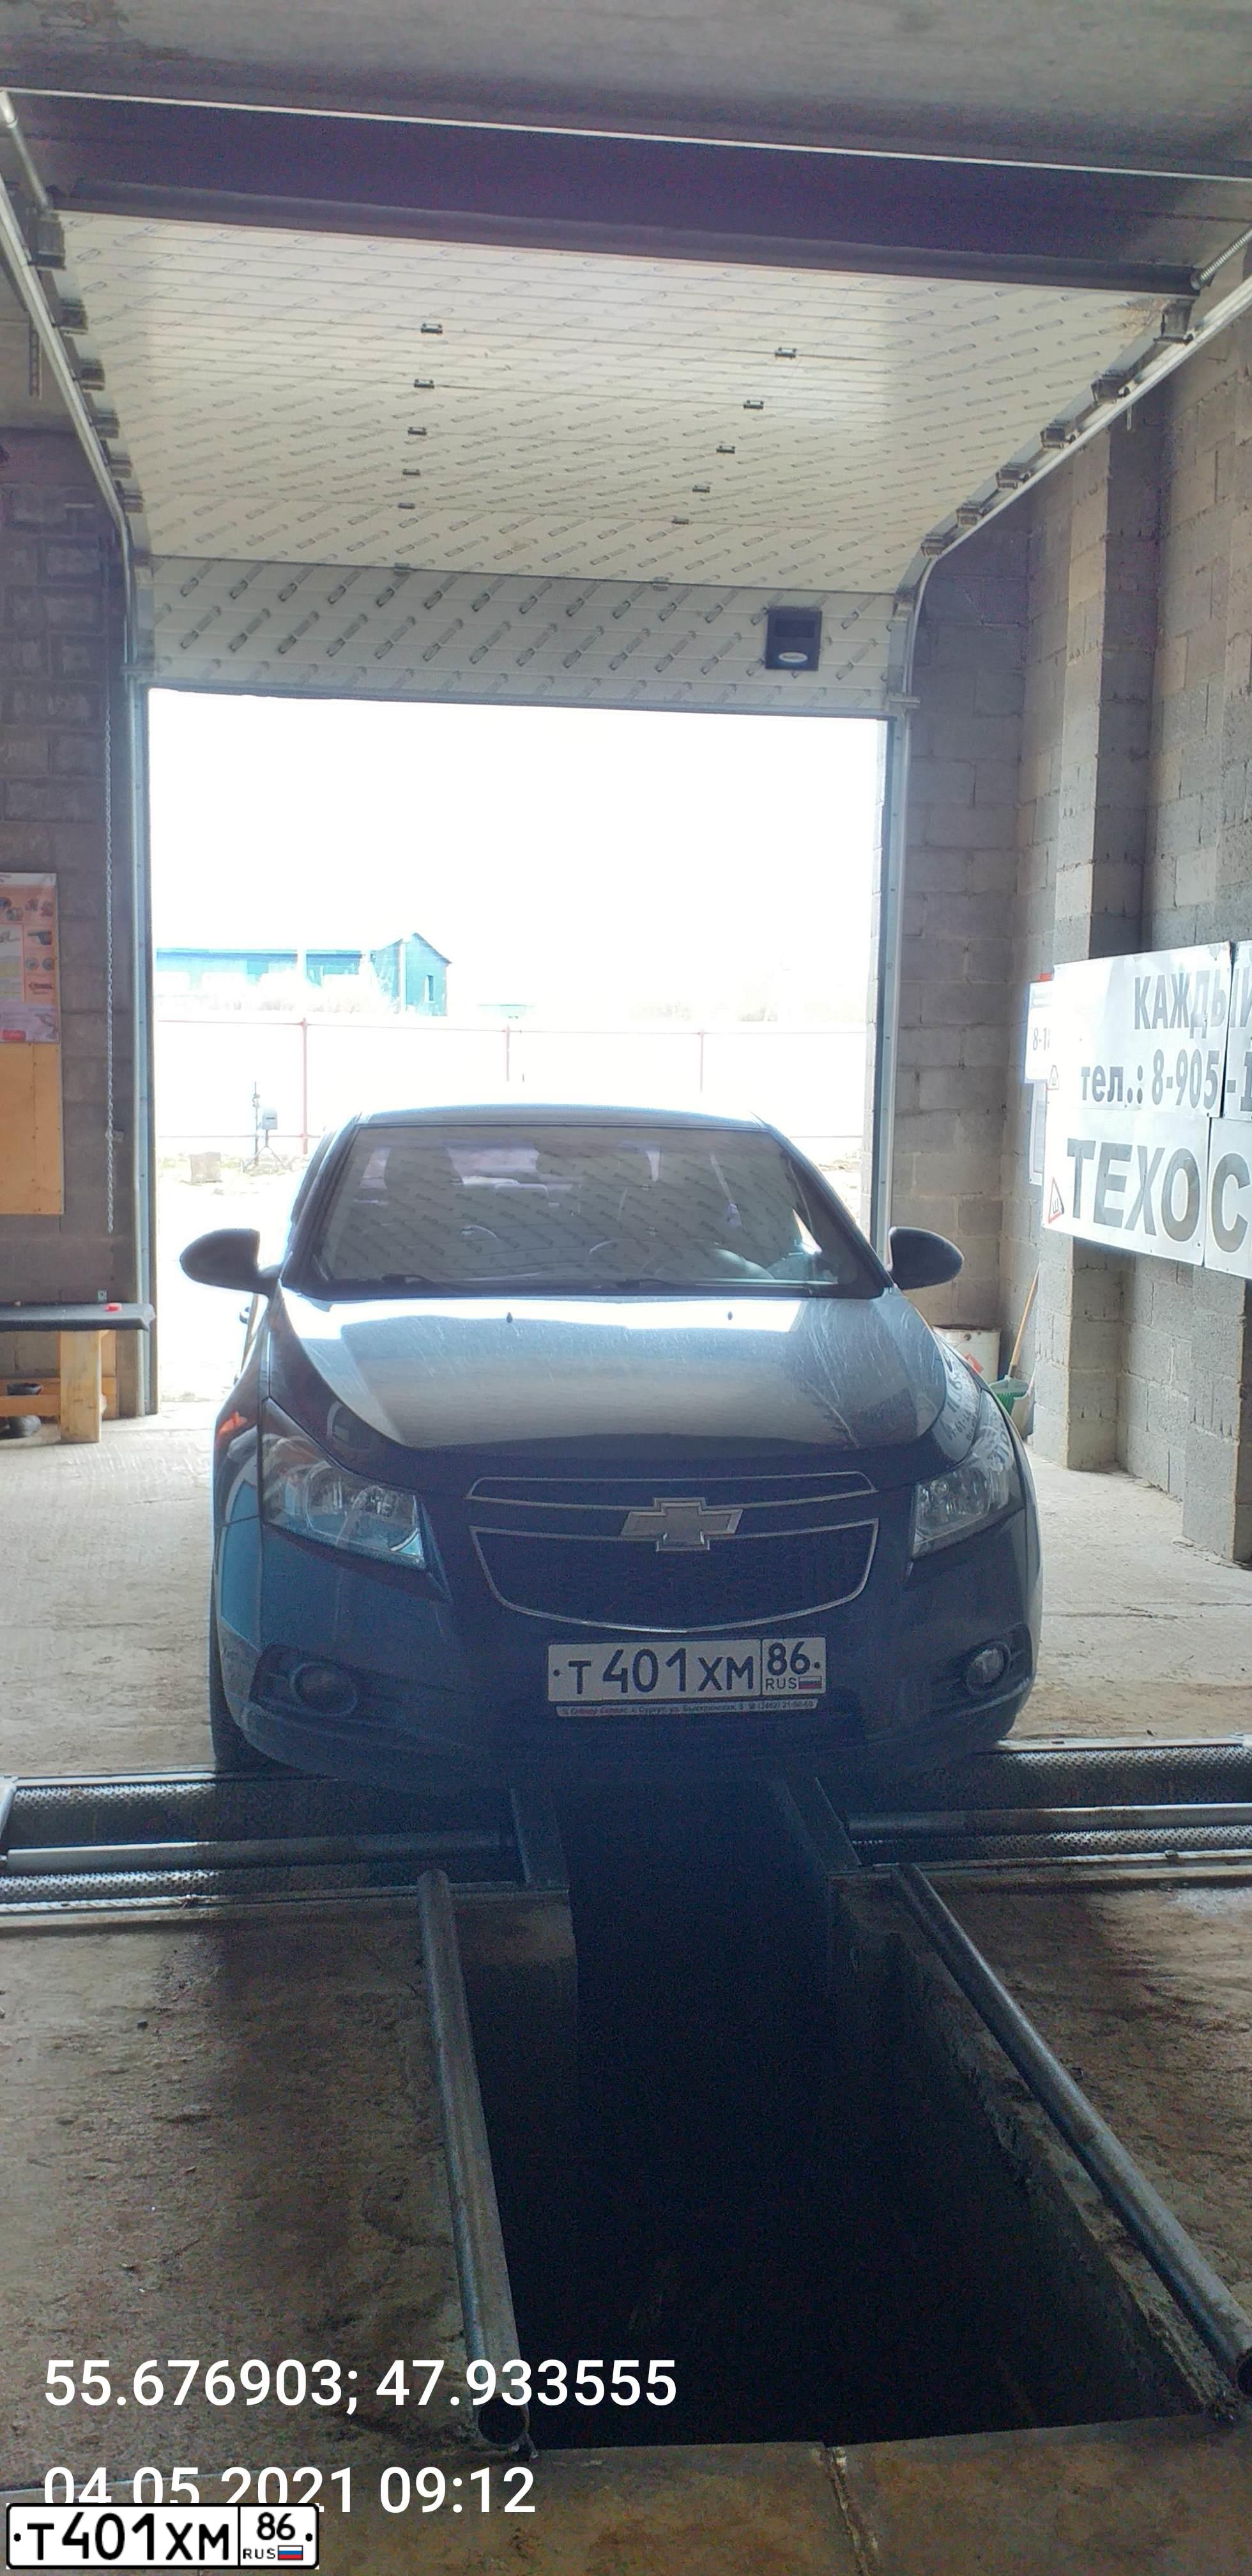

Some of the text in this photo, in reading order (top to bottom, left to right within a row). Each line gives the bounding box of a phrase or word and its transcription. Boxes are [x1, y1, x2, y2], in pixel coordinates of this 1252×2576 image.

[1080, 1064, 1143, 1105] тел.:
[767, 1641, 810, 1676] 86
[766, 1678, 797, 1690] RUS
